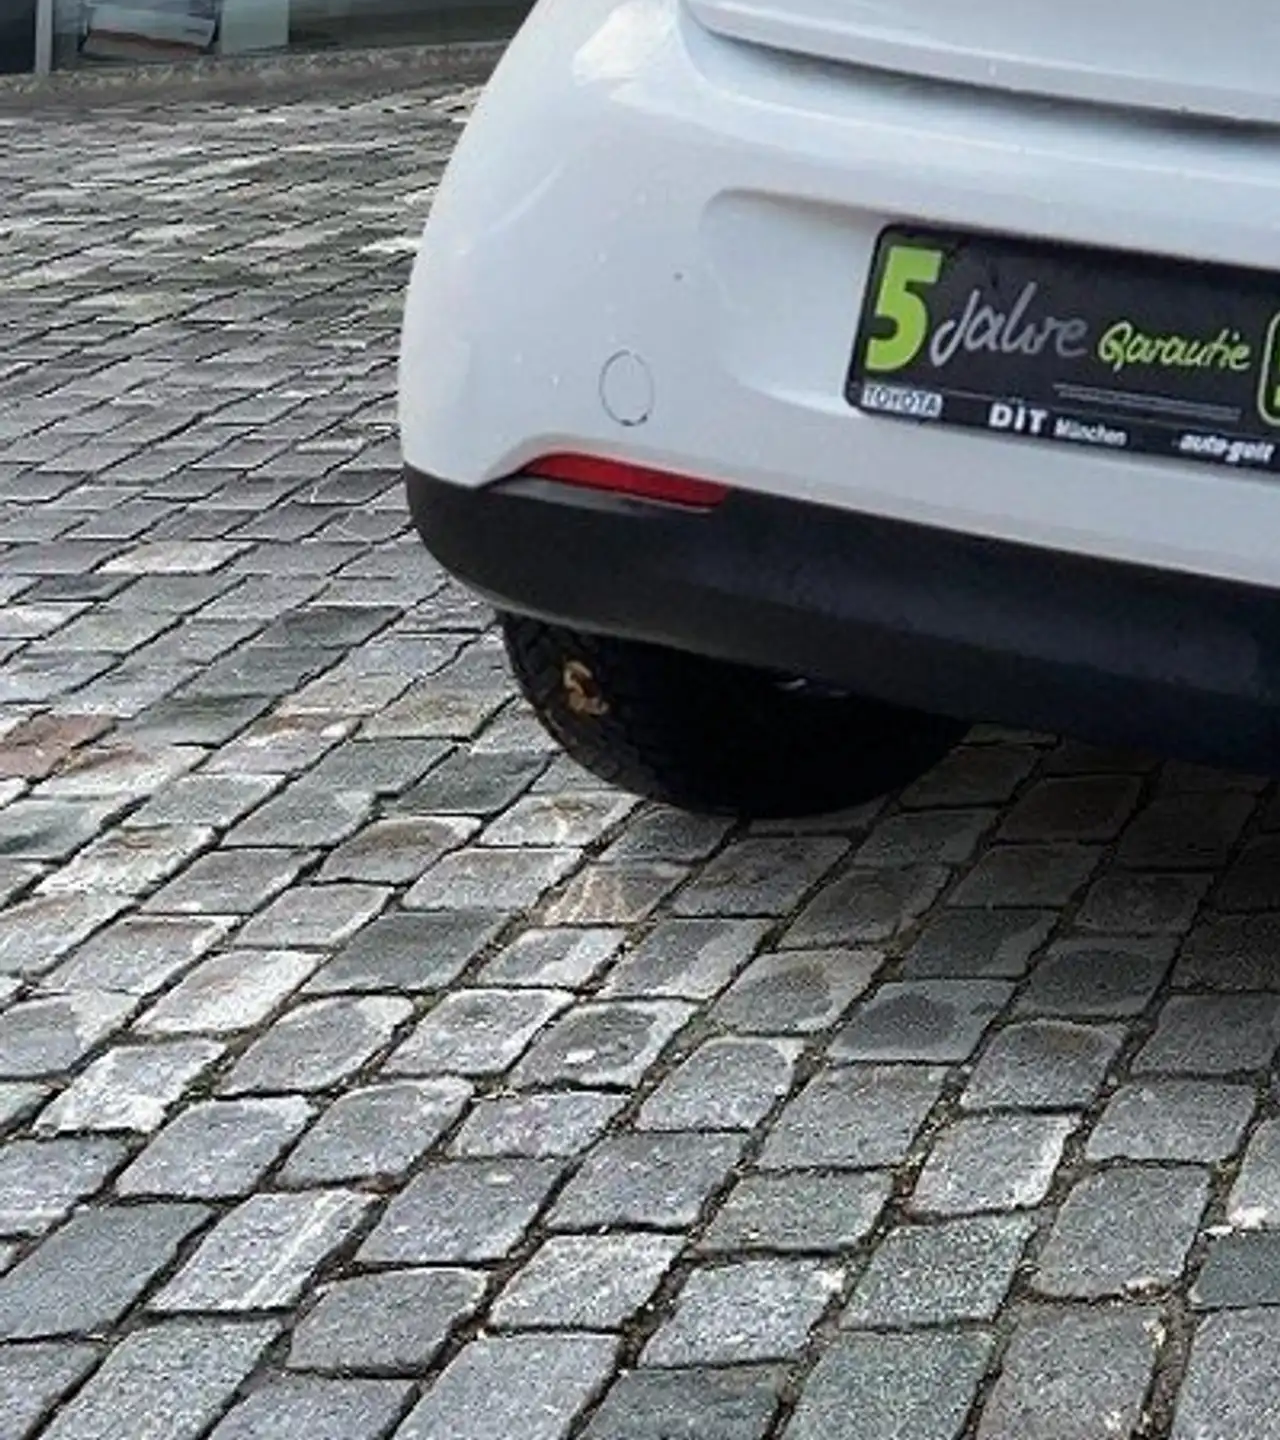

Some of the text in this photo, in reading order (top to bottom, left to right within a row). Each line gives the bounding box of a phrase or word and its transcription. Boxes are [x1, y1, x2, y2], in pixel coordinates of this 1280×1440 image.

[865, 245, 1250, 372] 5 Jahre Garantie
